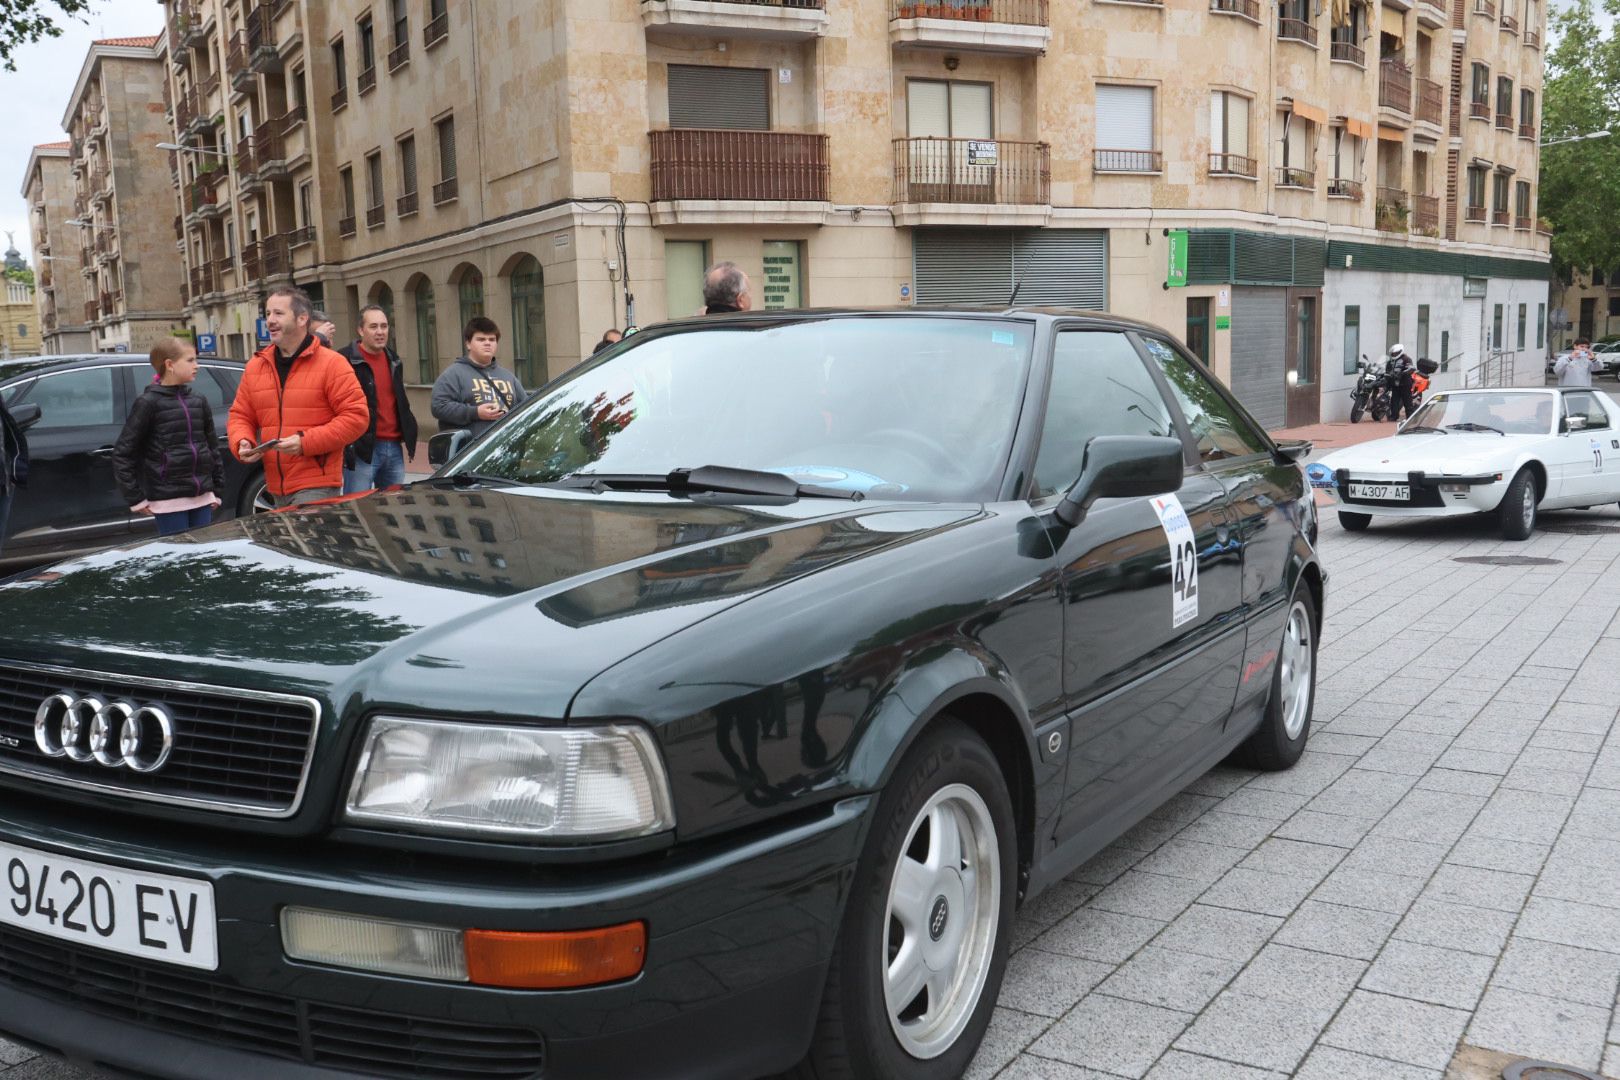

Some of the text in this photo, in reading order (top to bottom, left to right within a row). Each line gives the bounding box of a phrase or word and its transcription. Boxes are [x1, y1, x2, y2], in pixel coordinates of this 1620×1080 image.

[201, 336, 212, 349] P
[472, 378, 513, 395] JEDI
[1174, 540, 1197, 601] 42
[8, 857, 198, 954] 9420 EV
